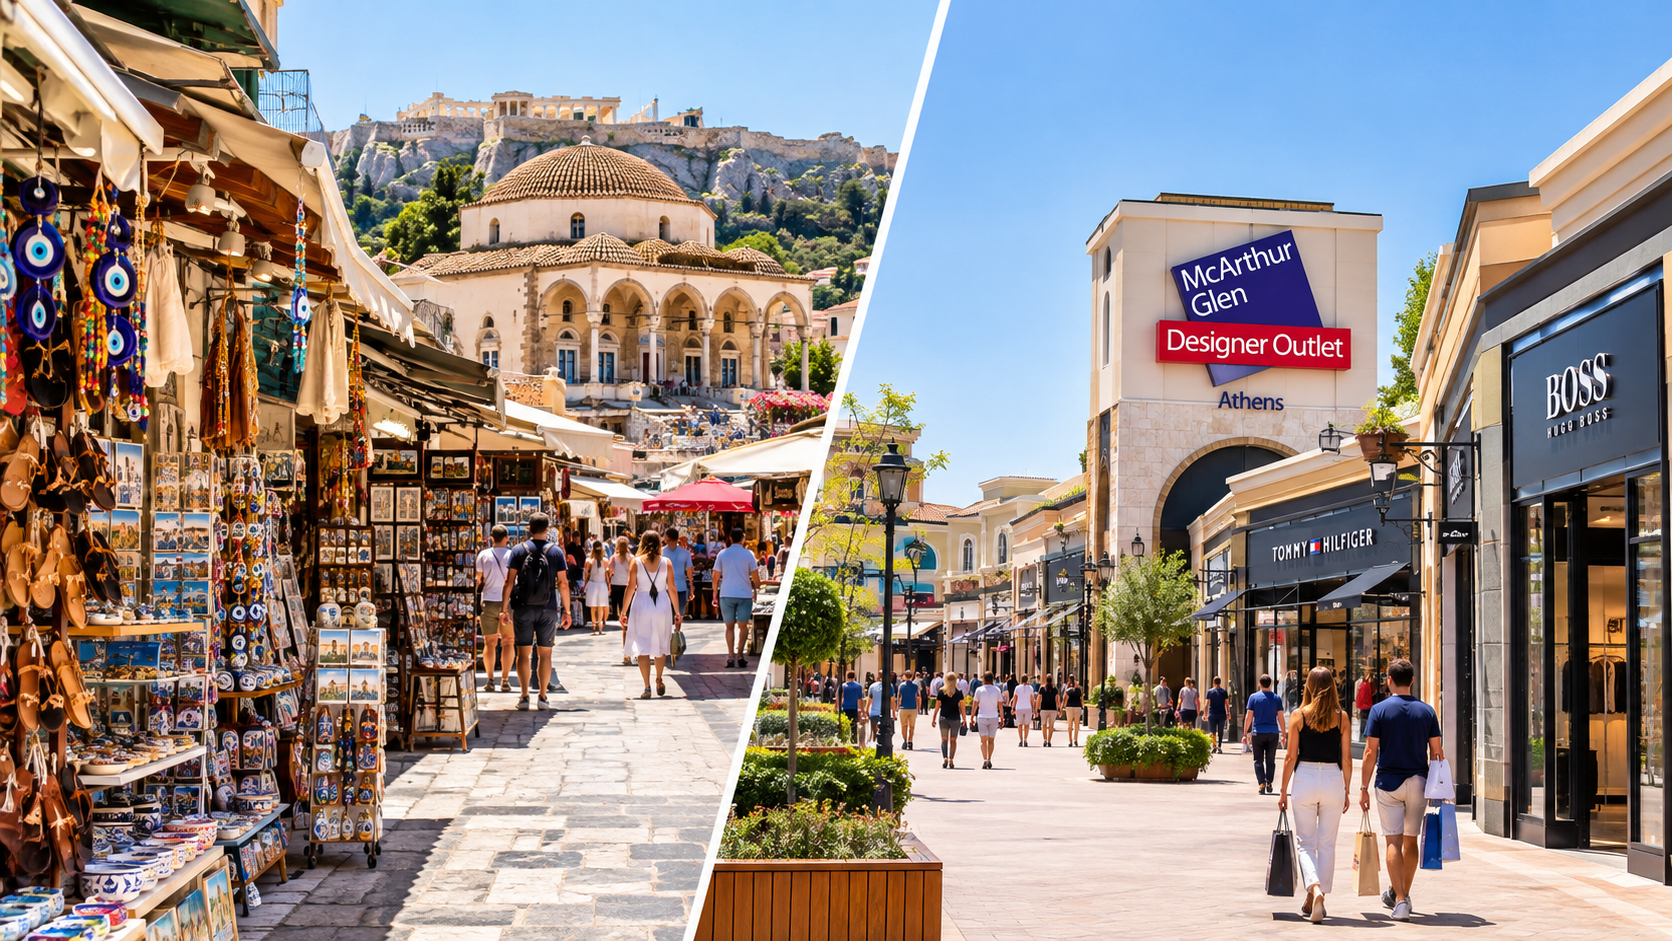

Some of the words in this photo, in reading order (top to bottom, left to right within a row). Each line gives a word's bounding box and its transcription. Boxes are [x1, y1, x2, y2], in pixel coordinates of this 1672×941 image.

[1180, 241, 1292, 292] McArthur
[1191, 286, 1248, 317] Glen
[1167, 328, 1268, 359] Designer
[1272, 333, 1344, 358] Outlet
[1218, 391, 1284, 411] Athens
[1546, 352, 1609, 420] BOSS
[1547, 420, 1574, 439] HUGO
[1579, 407, 1609, 428] BOSS
[1323, 528, 1374, 554] HILFIGER
